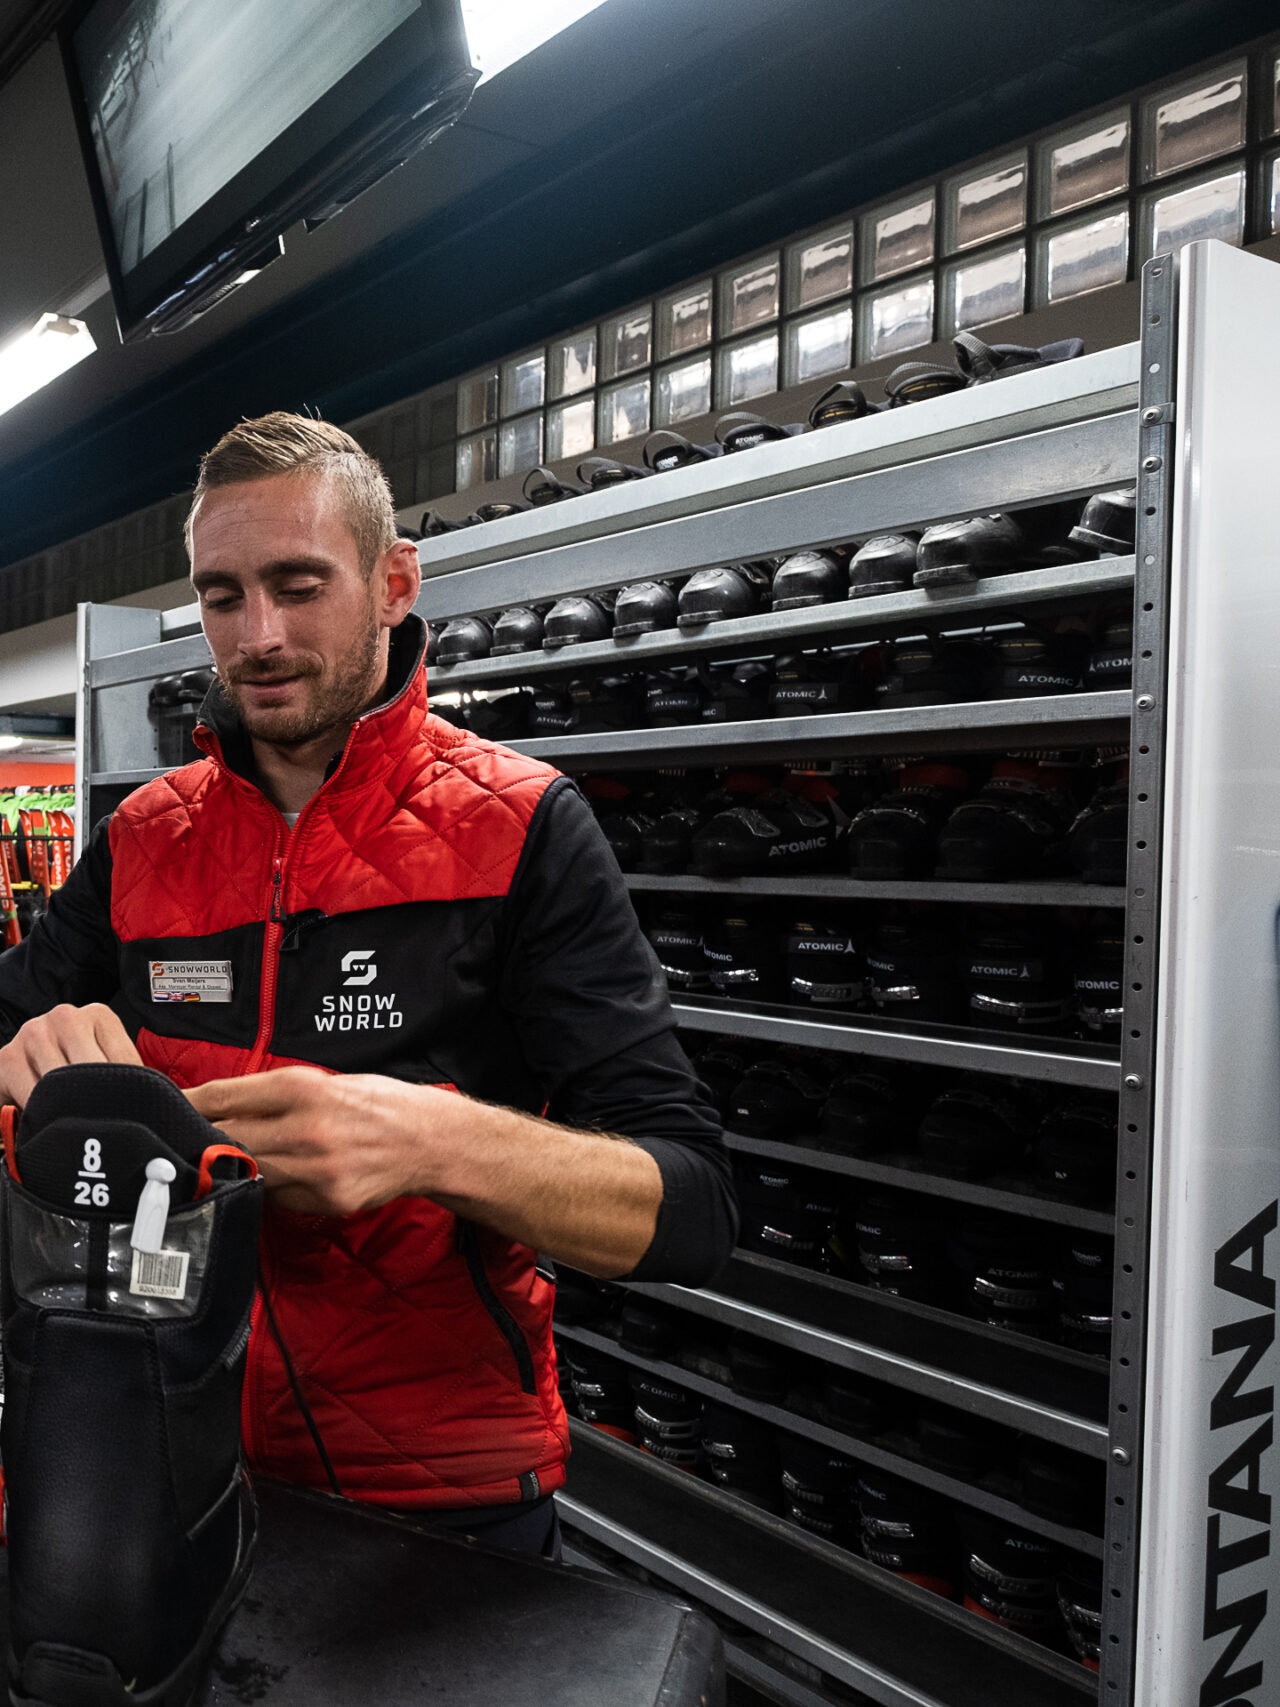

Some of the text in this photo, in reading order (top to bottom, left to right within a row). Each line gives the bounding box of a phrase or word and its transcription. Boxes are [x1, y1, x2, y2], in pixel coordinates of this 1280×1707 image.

[1096, 659, 1132, 668] ATOM
[1018, 674, 1074, 687] ATOMIC
[775, 690, 816, 699] ATOMIC
[769, 836, 828, 857] ATOMIC
[657, 936, 697, 945] ATOMIC
[798, 942, 844, 951] ATOMIC
[168, 965, 228, 974] SNOWWORLD
[970, 965, 1019, 976] ATOMIC
[322, 993, 396, 1012] SNOW
[314, 1011, 403, 1032] WORLD
[83, 1138, 102, 1172] 8
[73, 1181, 110, 1207] 26
[1199, 1198, 1279, 1707] NTANA
